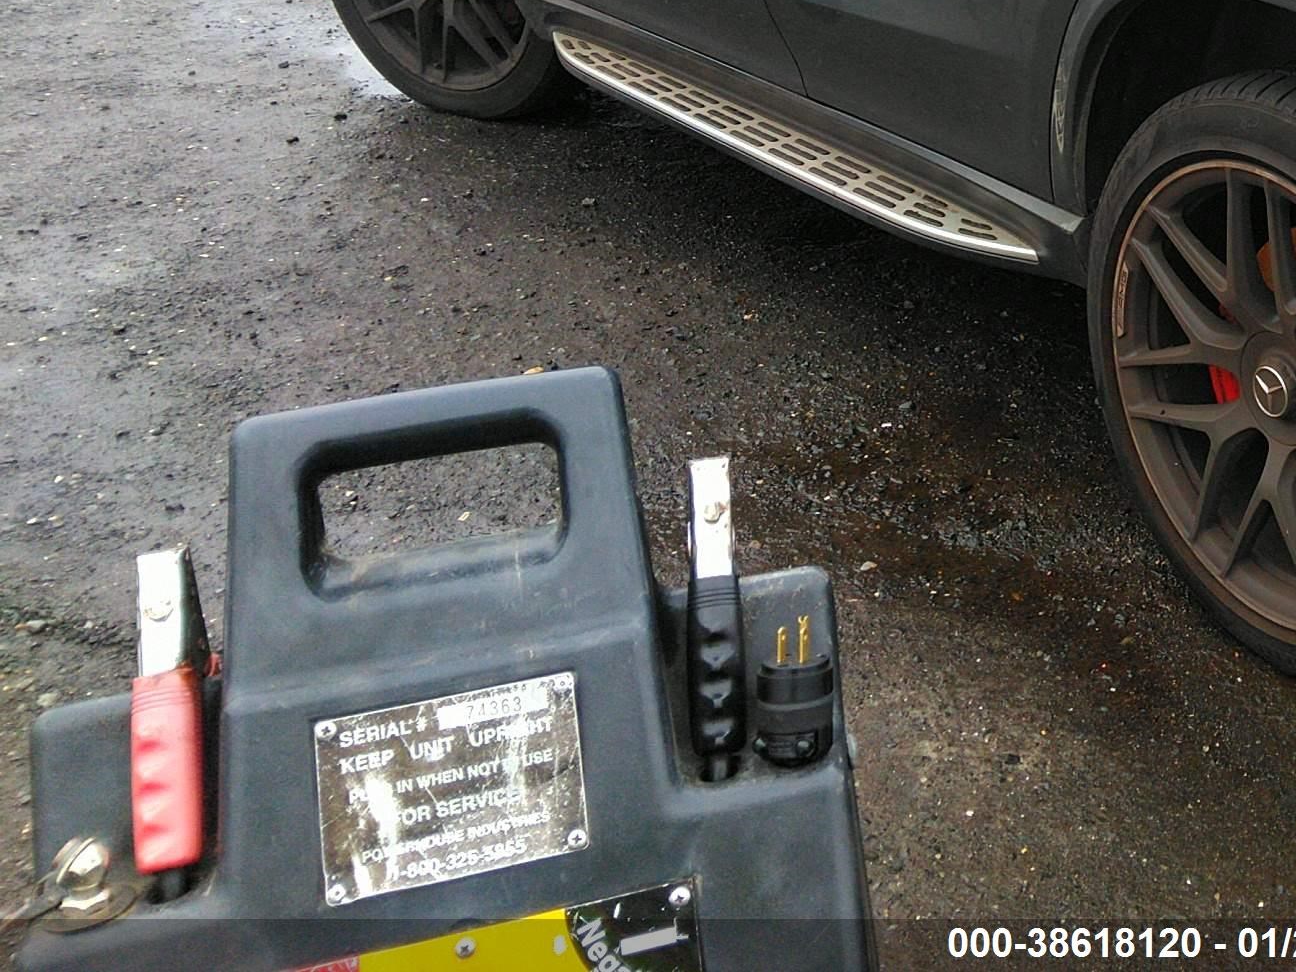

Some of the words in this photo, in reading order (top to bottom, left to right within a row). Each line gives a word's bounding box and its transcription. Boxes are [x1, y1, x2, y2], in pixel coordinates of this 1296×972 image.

[339, 719, 412, 748] SERIAL
[465, 696, 522, 721] 74363
[338, 749, 394, 775] KEEP
[411, 735, 456, 761] UNIT
[468, 716, 553, 747] UPRHT
[397, 778, 414, 794] IN
[416, 768, 464, 790] WHEN
[467, 760, 499, 781] NOT
[522, 748, 553, 767] USE
[393, 805, 431, 826] OR
[435, 788, 522, 818] SERVICE
[361, 828, 465, 864] POERHOUSE
